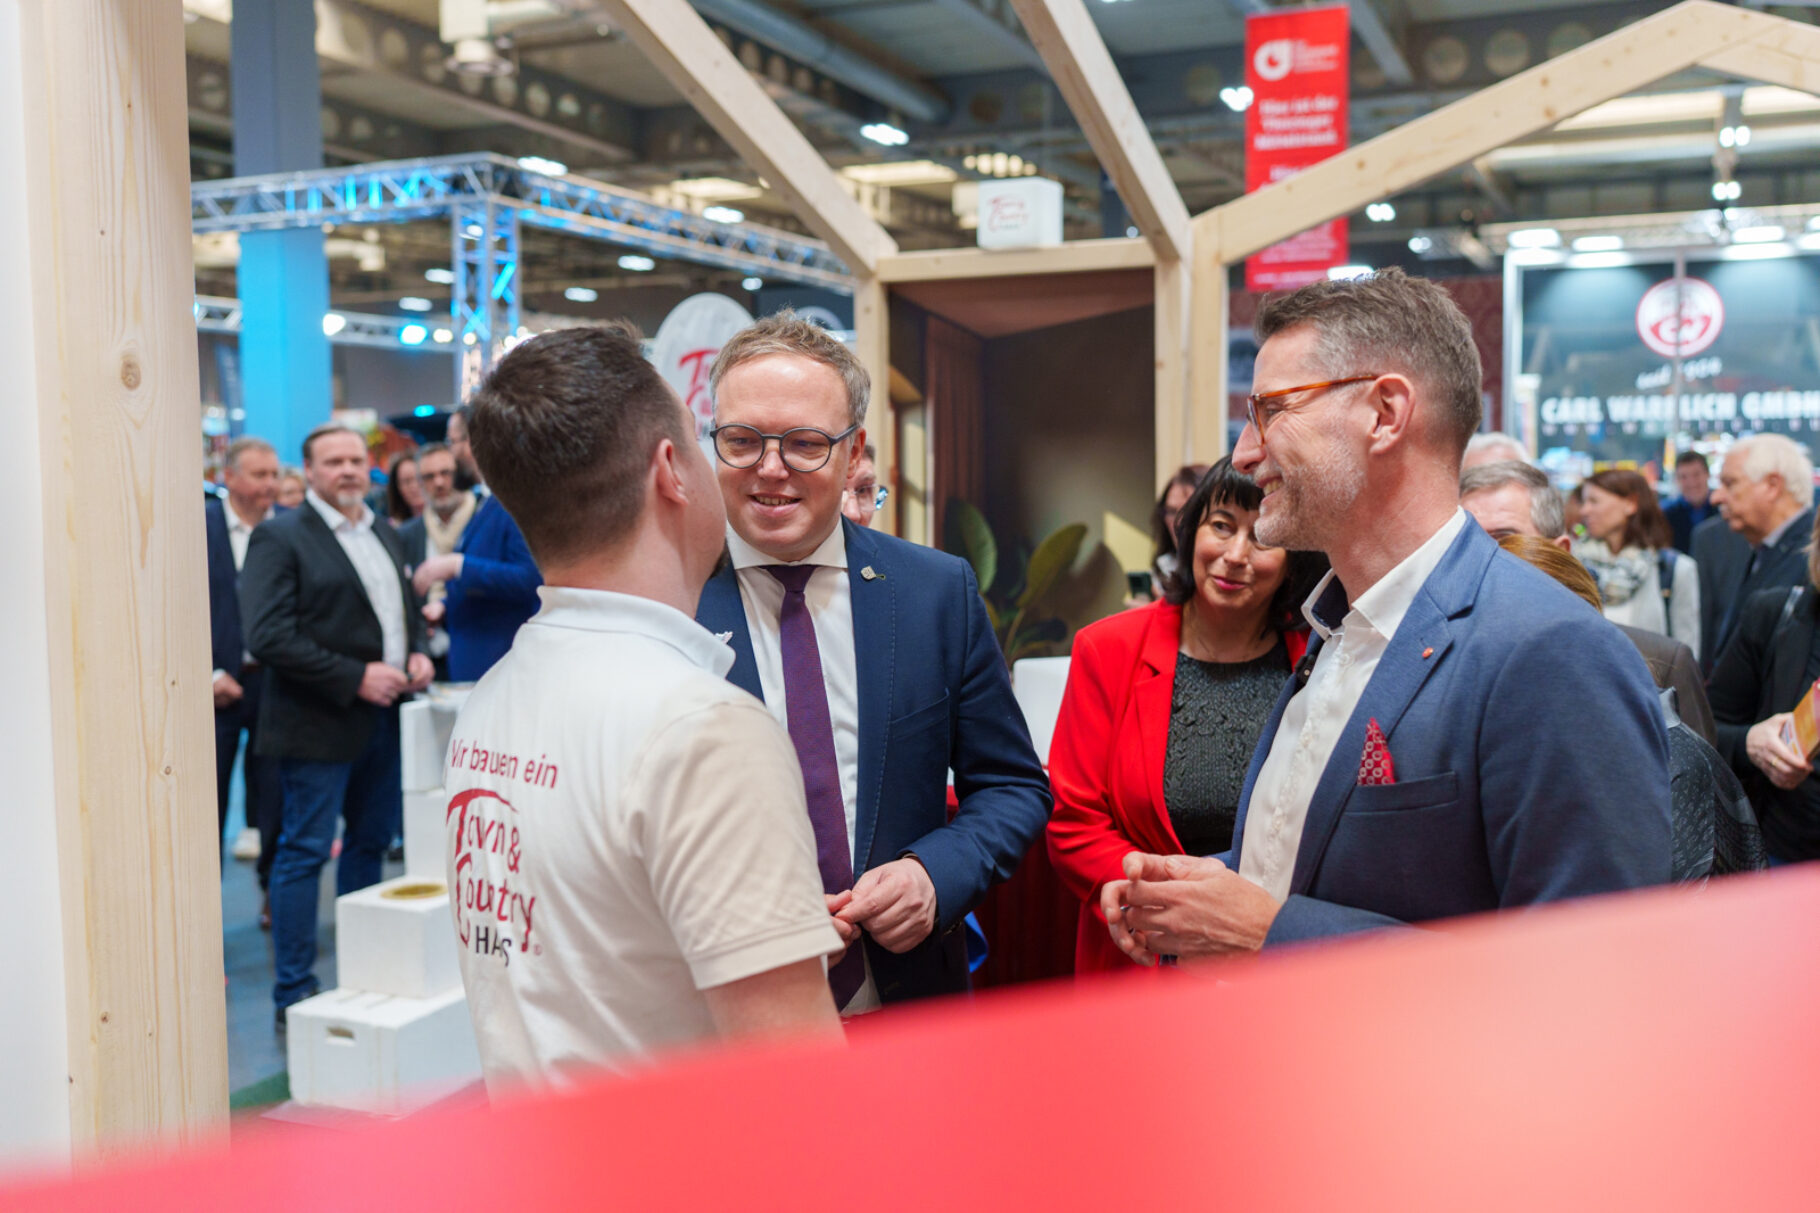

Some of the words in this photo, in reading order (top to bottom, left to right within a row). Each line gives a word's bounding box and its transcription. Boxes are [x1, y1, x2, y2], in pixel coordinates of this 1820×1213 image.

[1541, 396, 1604, 424] CARL
[470, 740, 518, 779] bauen
[524, 753, 557, 789] ein
[507, 825, 521, 873] &
